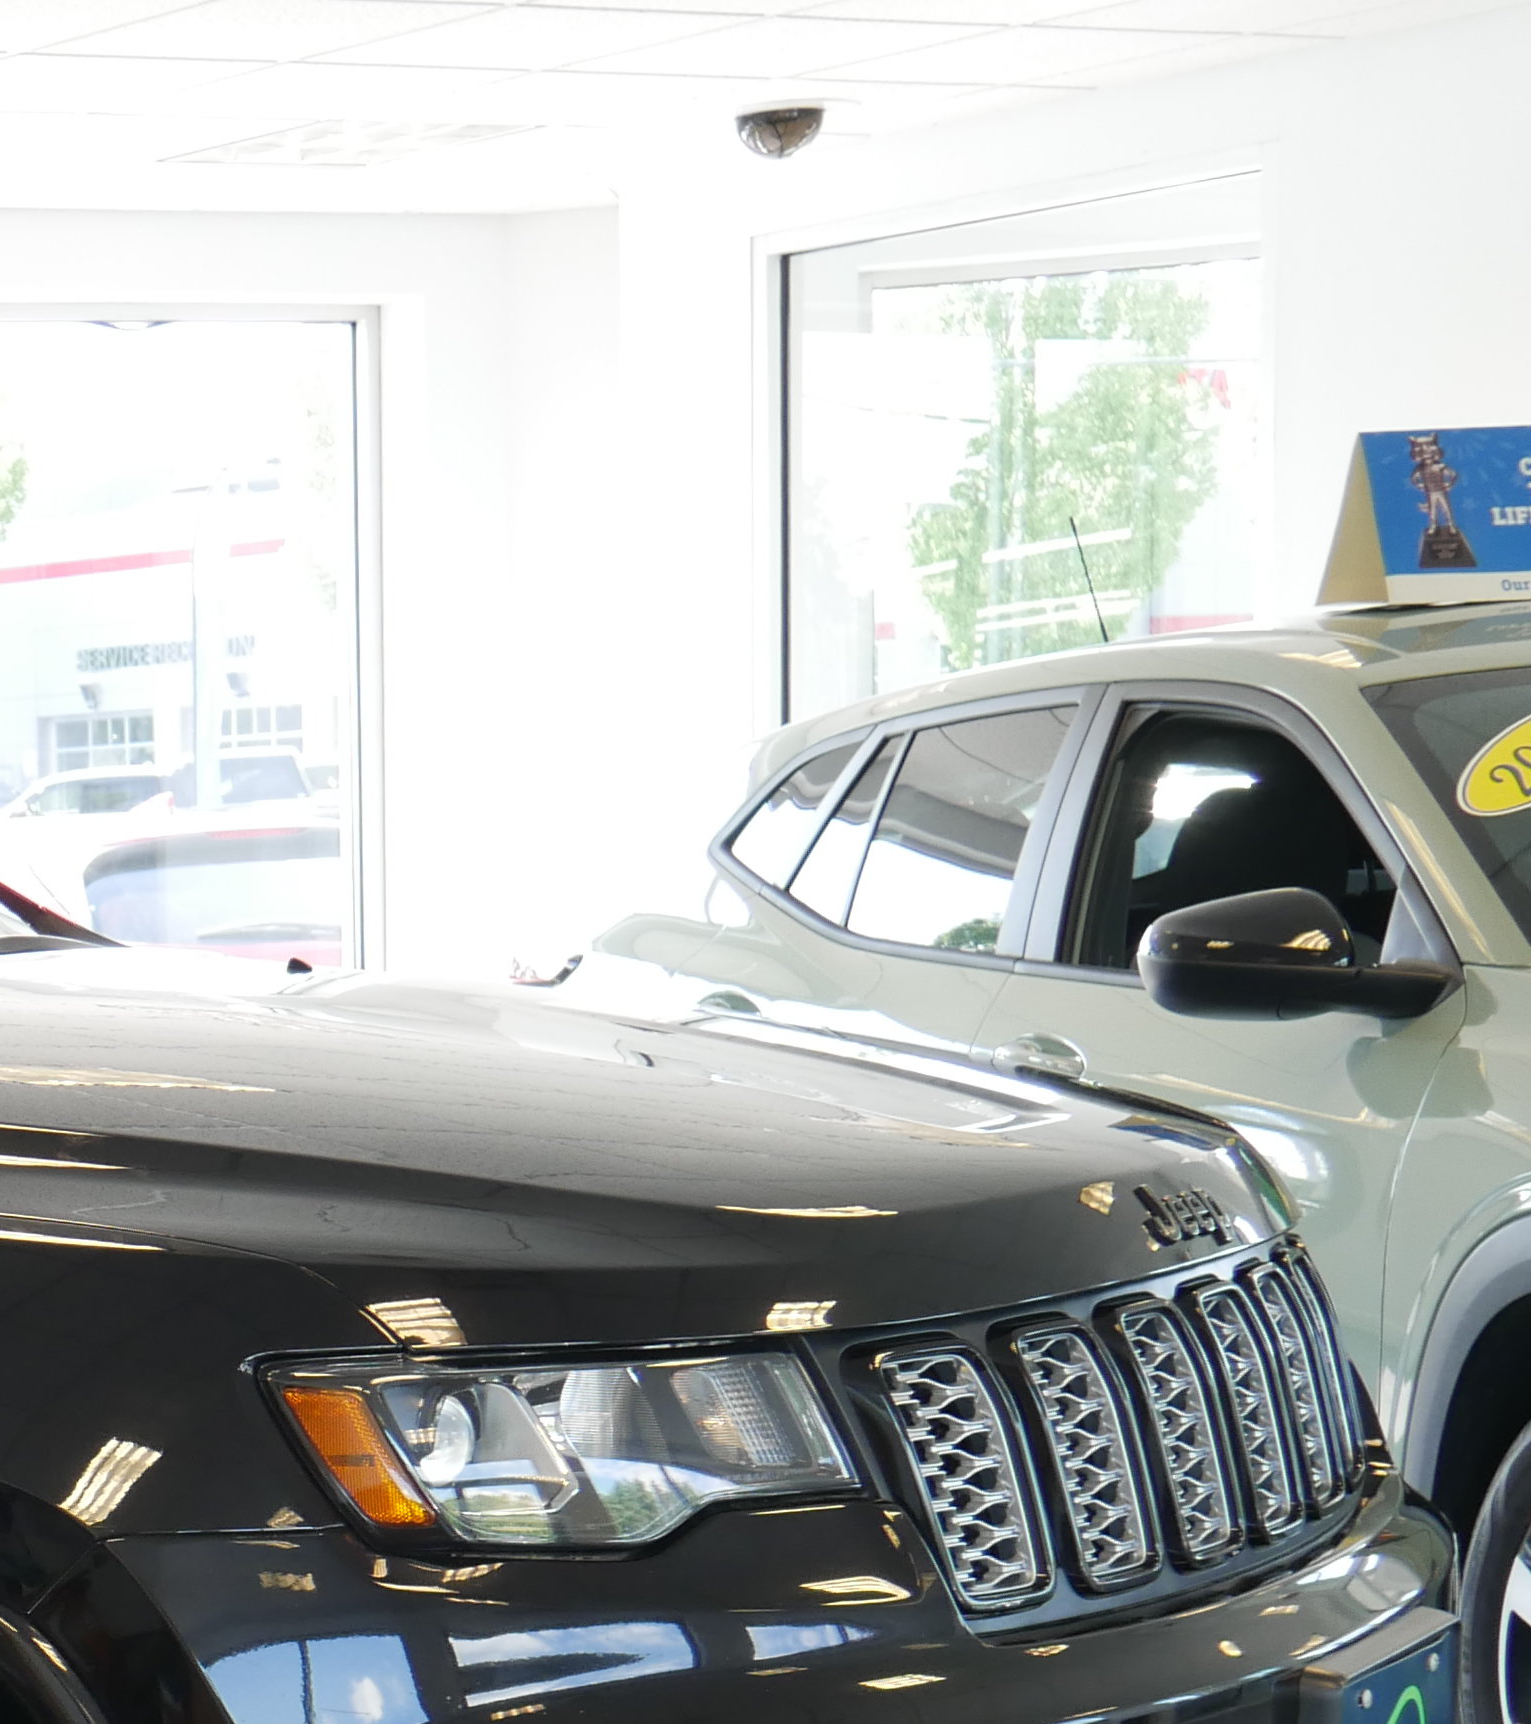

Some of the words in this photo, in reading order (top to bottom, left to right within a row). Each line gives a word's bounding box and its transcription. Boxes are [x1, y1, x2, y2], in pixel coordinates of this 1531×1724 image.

[1501, 579, 1531, 592] Our
[76, 643, 150, 673] SERVICE
[1133, 1184, 1233, 1246] Jeep
